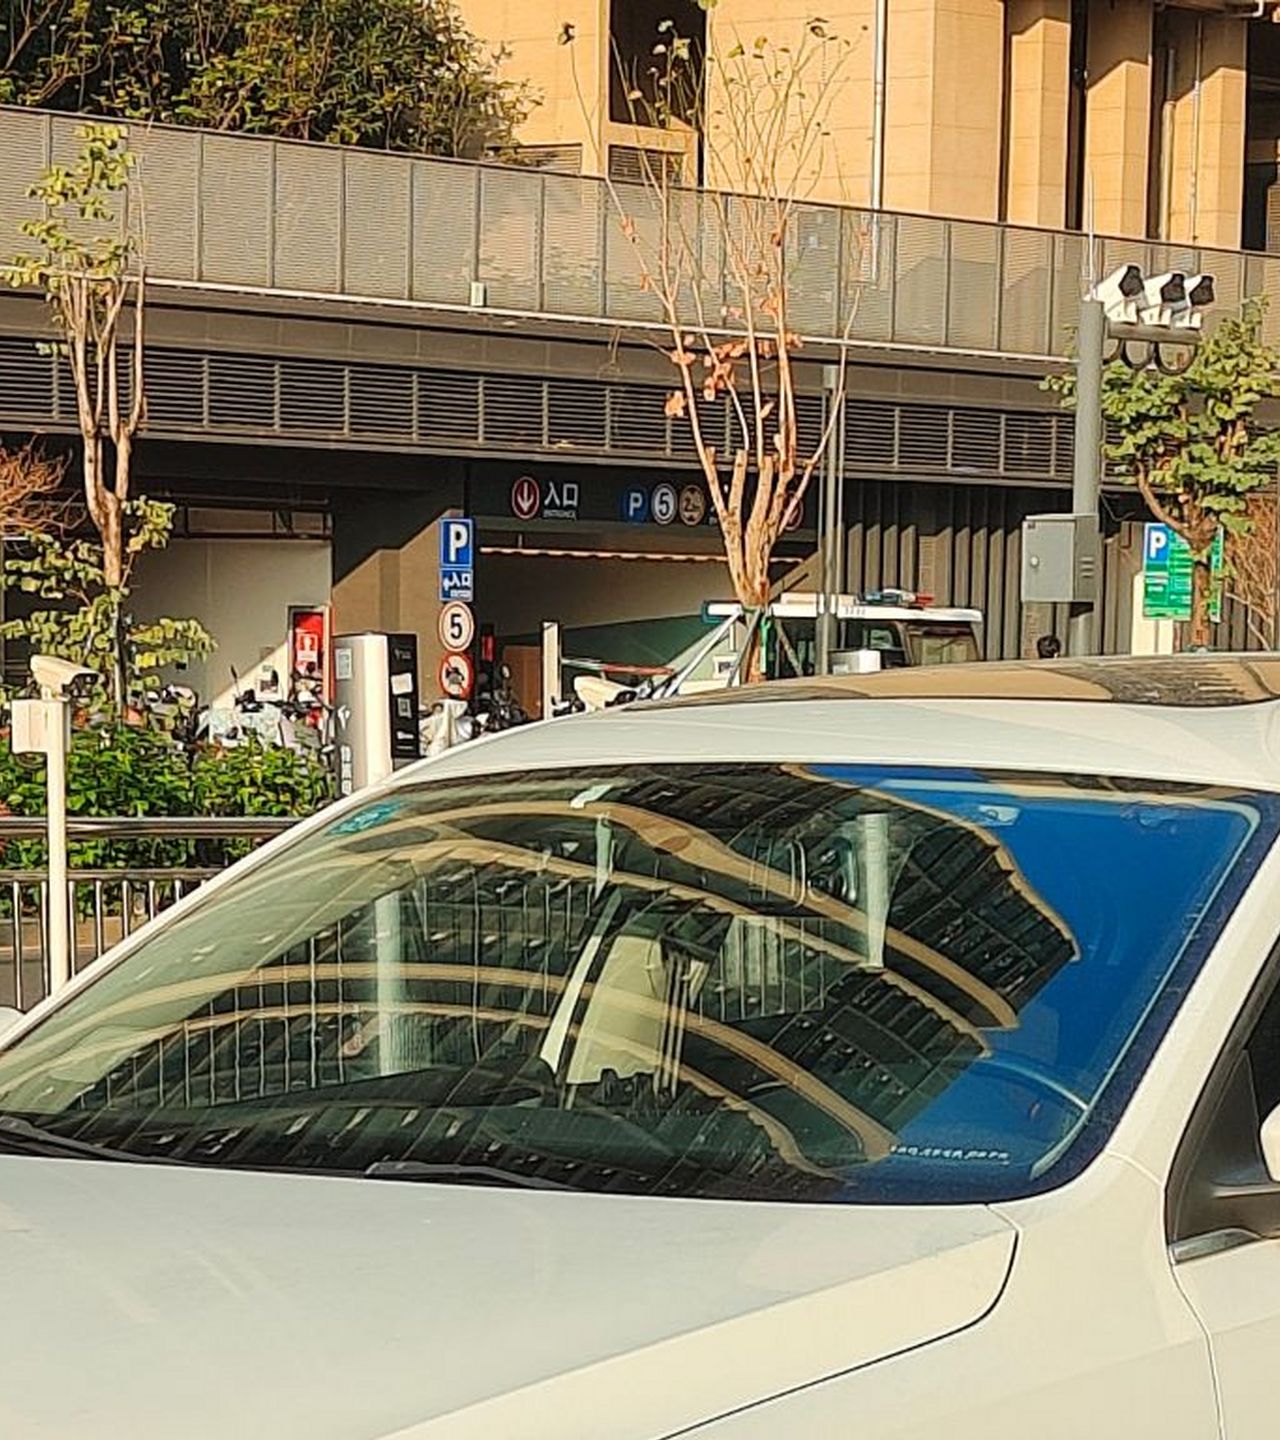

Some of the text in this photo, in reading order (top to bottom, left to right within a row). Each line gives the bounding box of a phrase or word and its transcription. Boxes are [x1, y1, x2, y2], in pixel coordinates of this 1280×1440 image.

[544, 481, 578, 507] 入口
[629, 492, 643, 517] P
[659, 491, 671, 517] 5
[449, 523, 468, 563] P
[1150, 530, 1167, 558] P
[450, 613, 463, 640] 5
